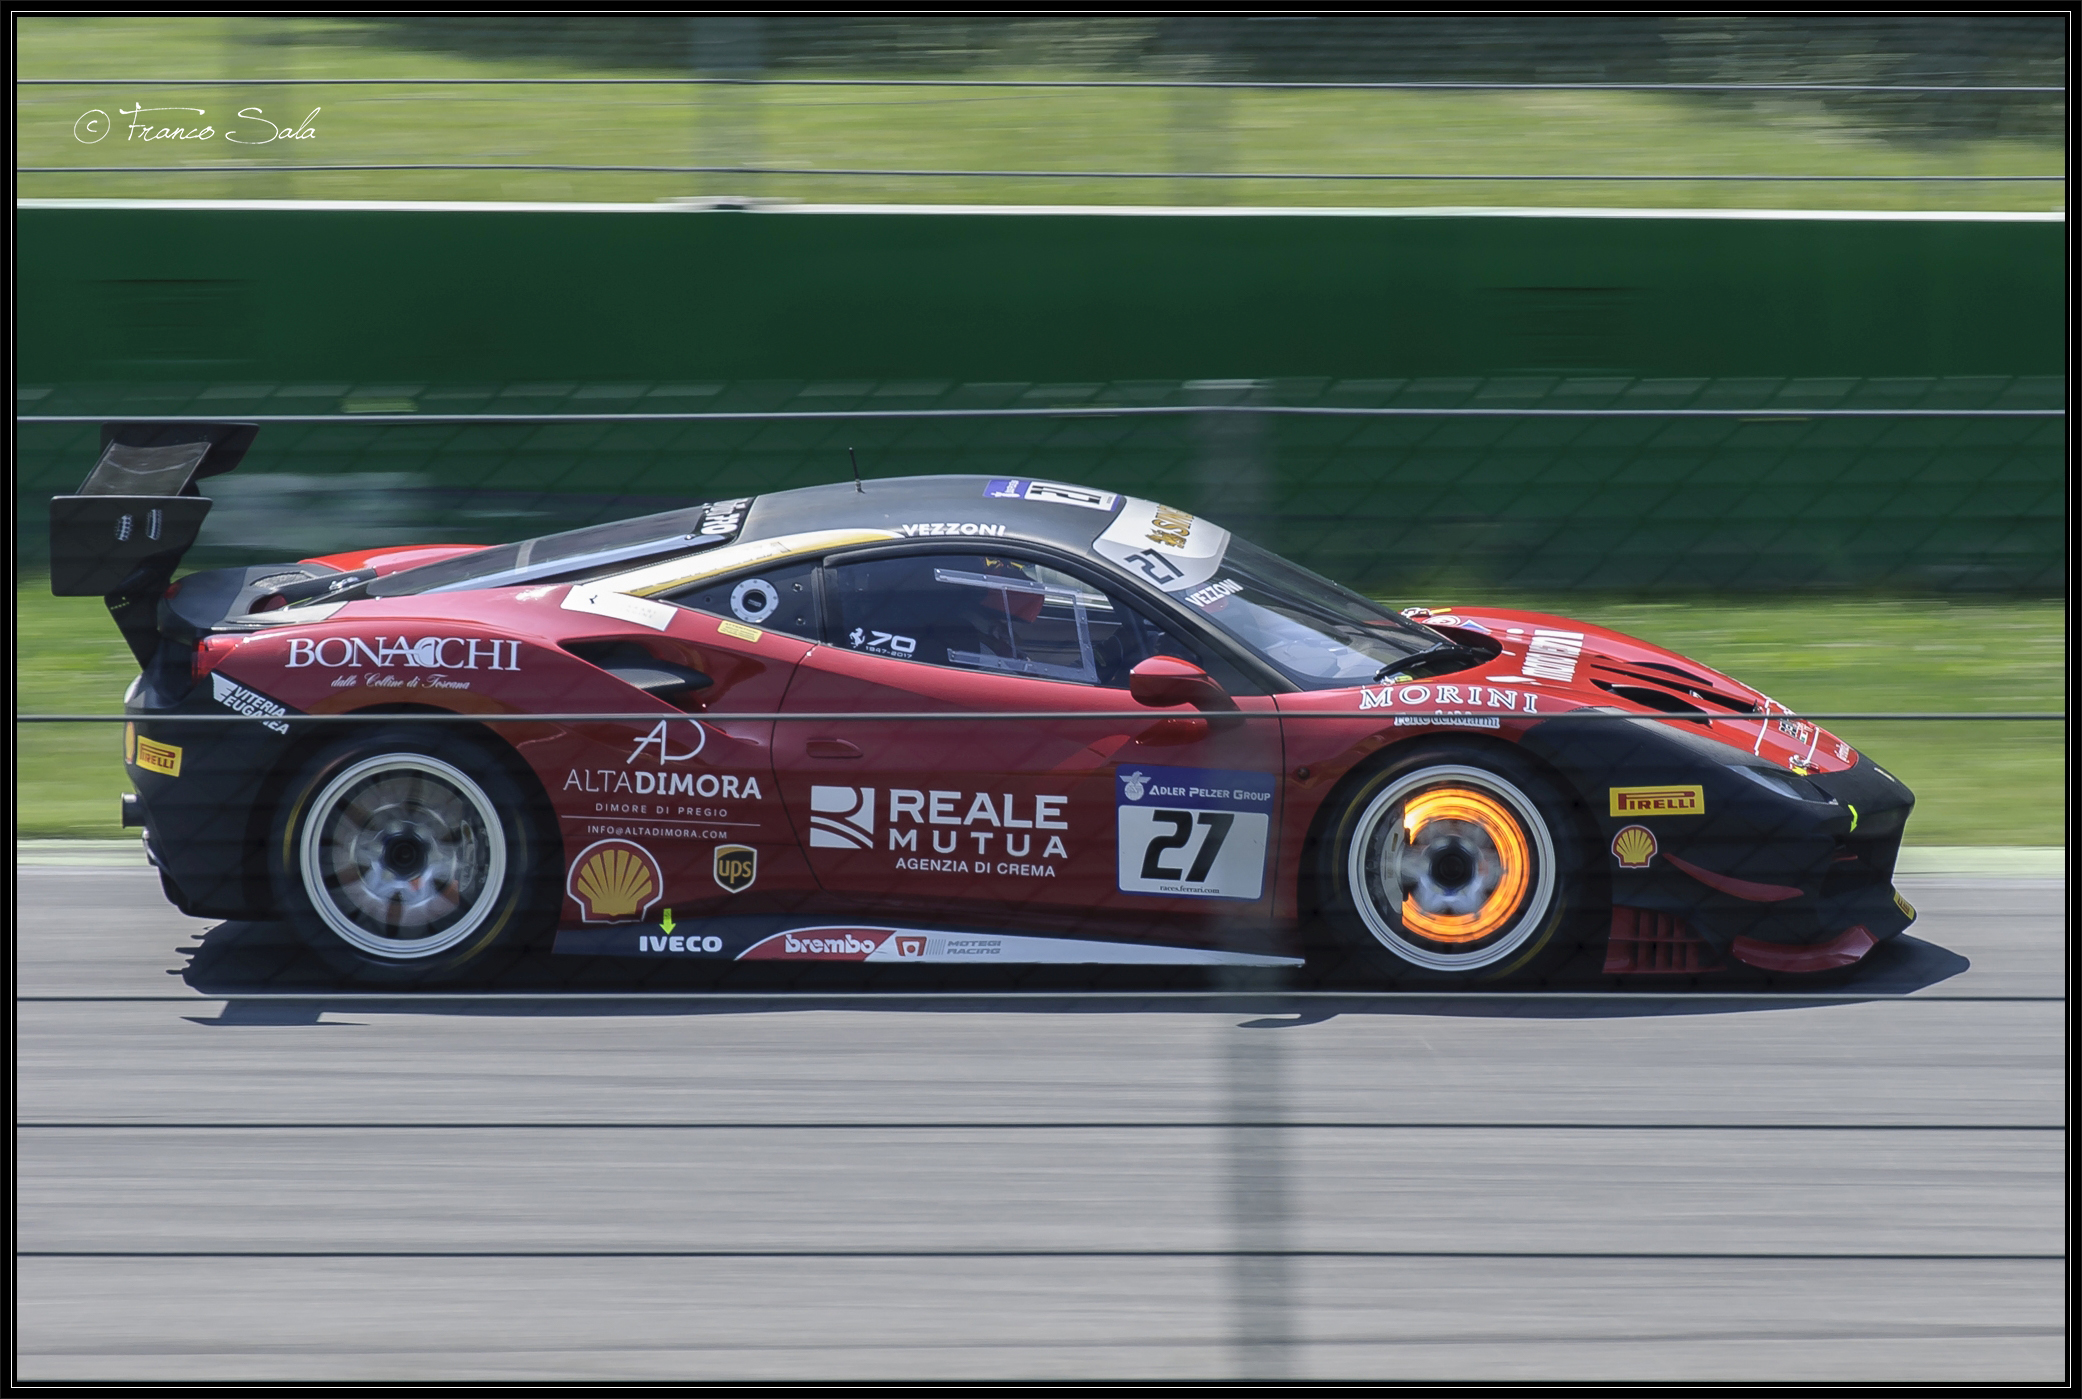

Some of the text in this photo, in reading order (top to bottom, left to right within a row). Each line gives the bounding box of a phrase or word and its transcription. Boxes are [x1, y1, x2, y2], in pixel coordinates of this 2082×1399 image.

[901, 522, 1007, 537] VEZZONI
[1123, 548, 1185, 586] 27
[1184, 578, 1244, 607] VEZZONI
[284, 636, 523, 671] BONACCHI
[865, 645, 913, 659] 1947-2017
[867, 630, 917, 654] 70
[406, 675, 420, 688] di
[234, 686, 286, 718] VITERIA
[1359, 684, 1538, 714] MORINI
[139, 743, 176, 770] PIRELLI
[563, 768, 762, 800] ALTADIMORA
[1149, 784, 1271, 801] ADLER PELZER GROUP
[595, 803, 728, 818] DIMORE DI PREGIO
[889, 788, 1069, 830] REALE
[1617, 790, 1696, 810] PIRELLI
[587, 825, 728, 839] INFO@ALTADIMORA.COM
[889, 828, 1068, 859] MUTUA
[1140, 809, 1235, 883] 27
[718, 859, 752, 884] ups
[895, 857, 1056, 878] AGENZIA DI CREMA
[1159, 885, 1220, 894] races.ferrari.com
[639, 935, 723, 953] IVECO
[785, 933, 876, 954] brembo
